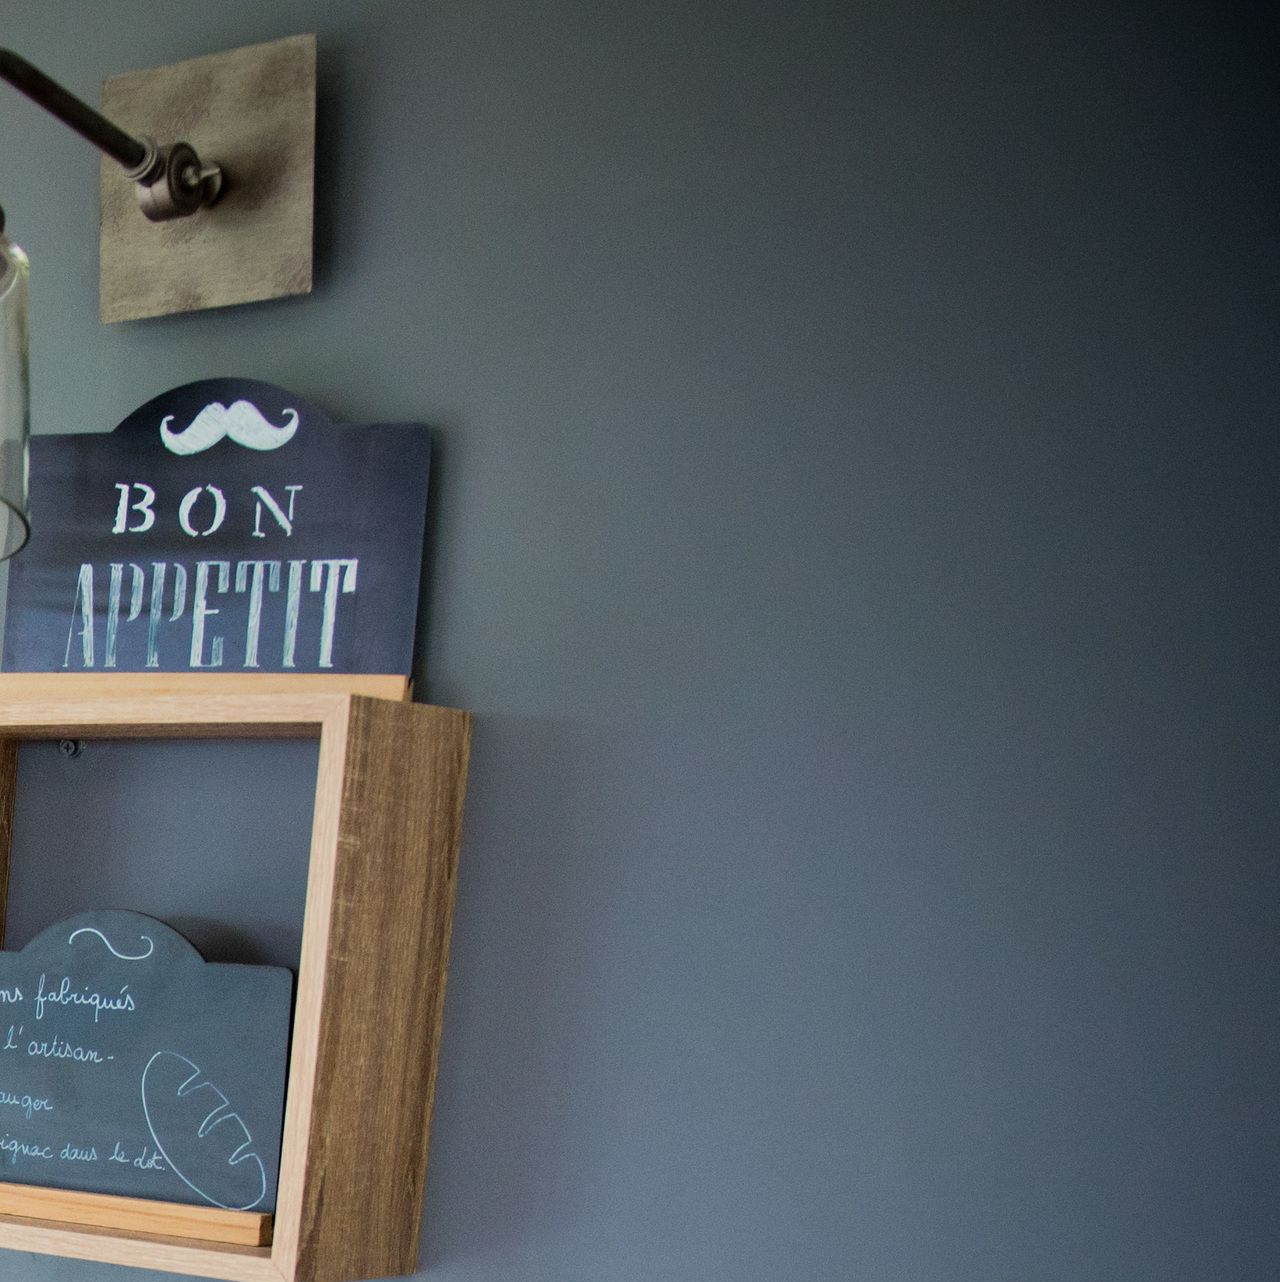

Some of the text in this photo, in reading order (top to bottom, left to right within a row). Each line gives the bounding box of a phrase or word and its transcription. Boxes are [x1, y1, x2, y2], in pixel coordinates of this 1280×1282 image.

[111, 482, 303, 537] BON
[62, 558, 358, 668] APPETIT
[34, 974, 136, 1023] fabriqués
[60, 1143, 98, 1161] dans
[109, 1142, 130, 1163] le
